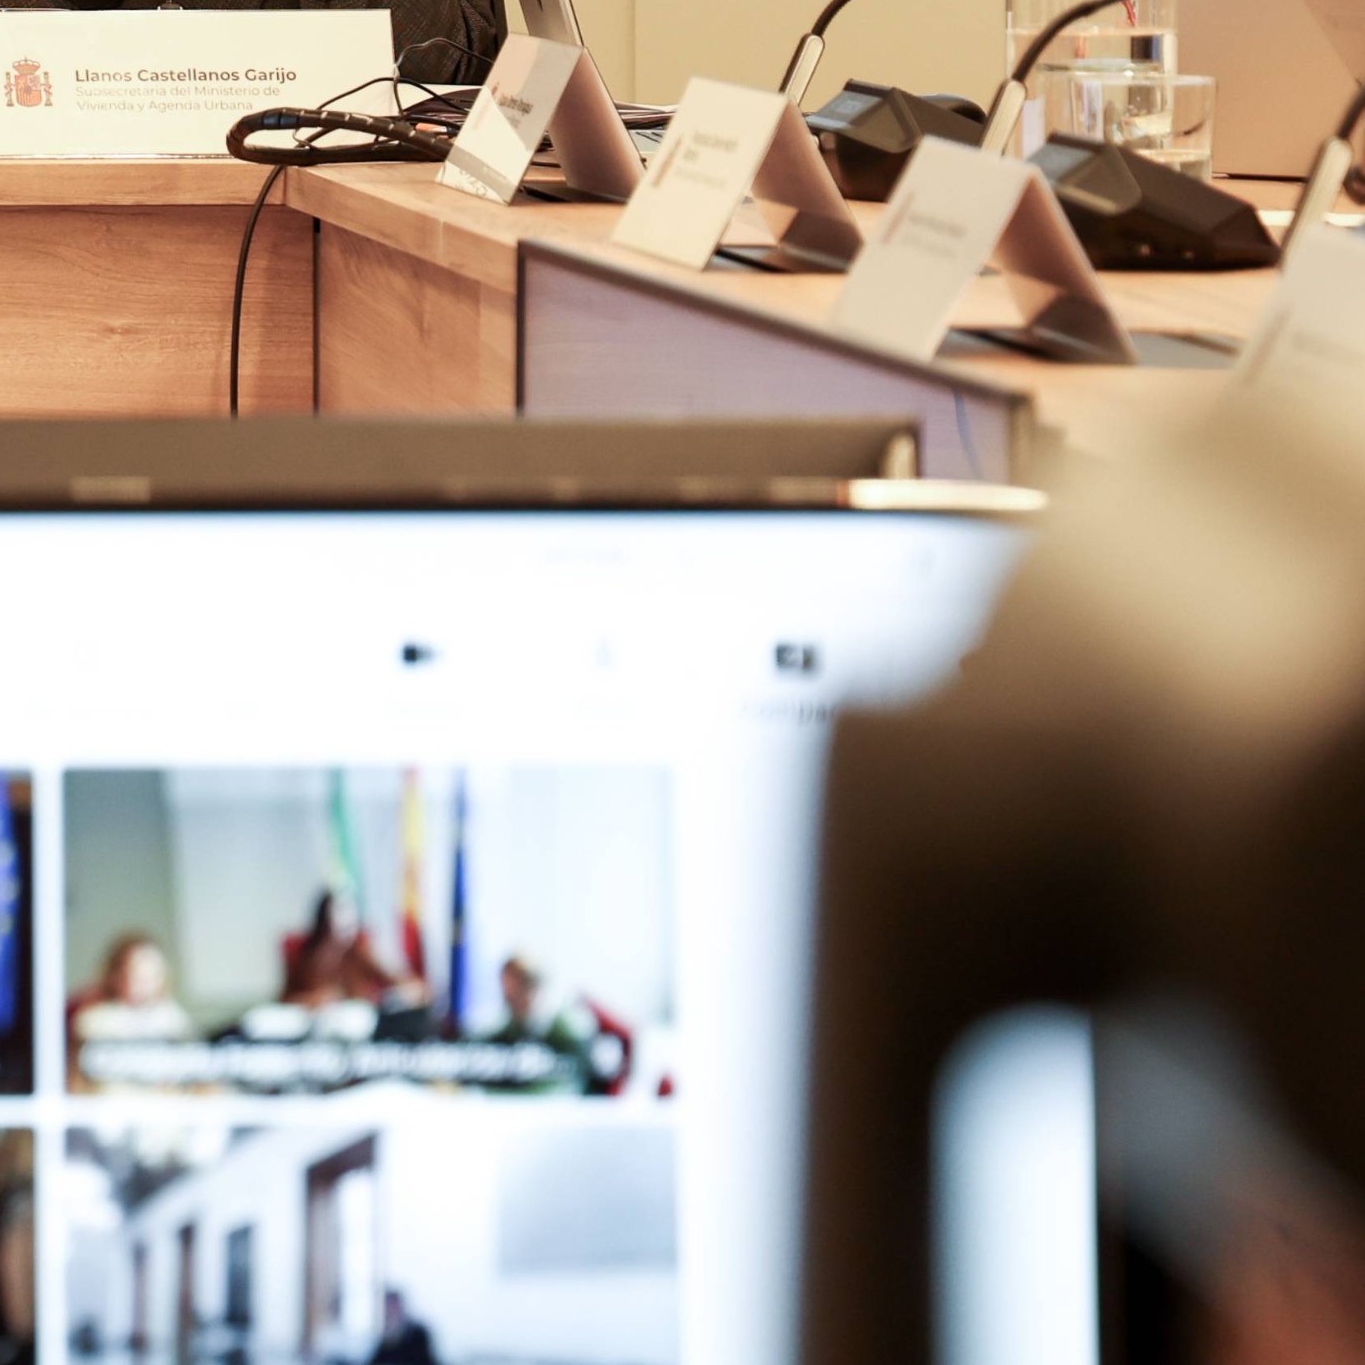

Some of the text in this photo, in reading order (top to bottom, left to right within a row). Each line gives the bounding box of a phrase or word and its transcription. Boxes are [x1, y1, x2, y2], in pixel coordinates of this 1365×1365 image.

[75, 67, 297, 84] Llanos Castellanos Garijo
[169, 86, 191, 97] del
[194, 85, 261, 96] Ministerio
[263, 86, 281, 96] de
[76, 100, 253, 113] Vivienda y Agenda Urbana
